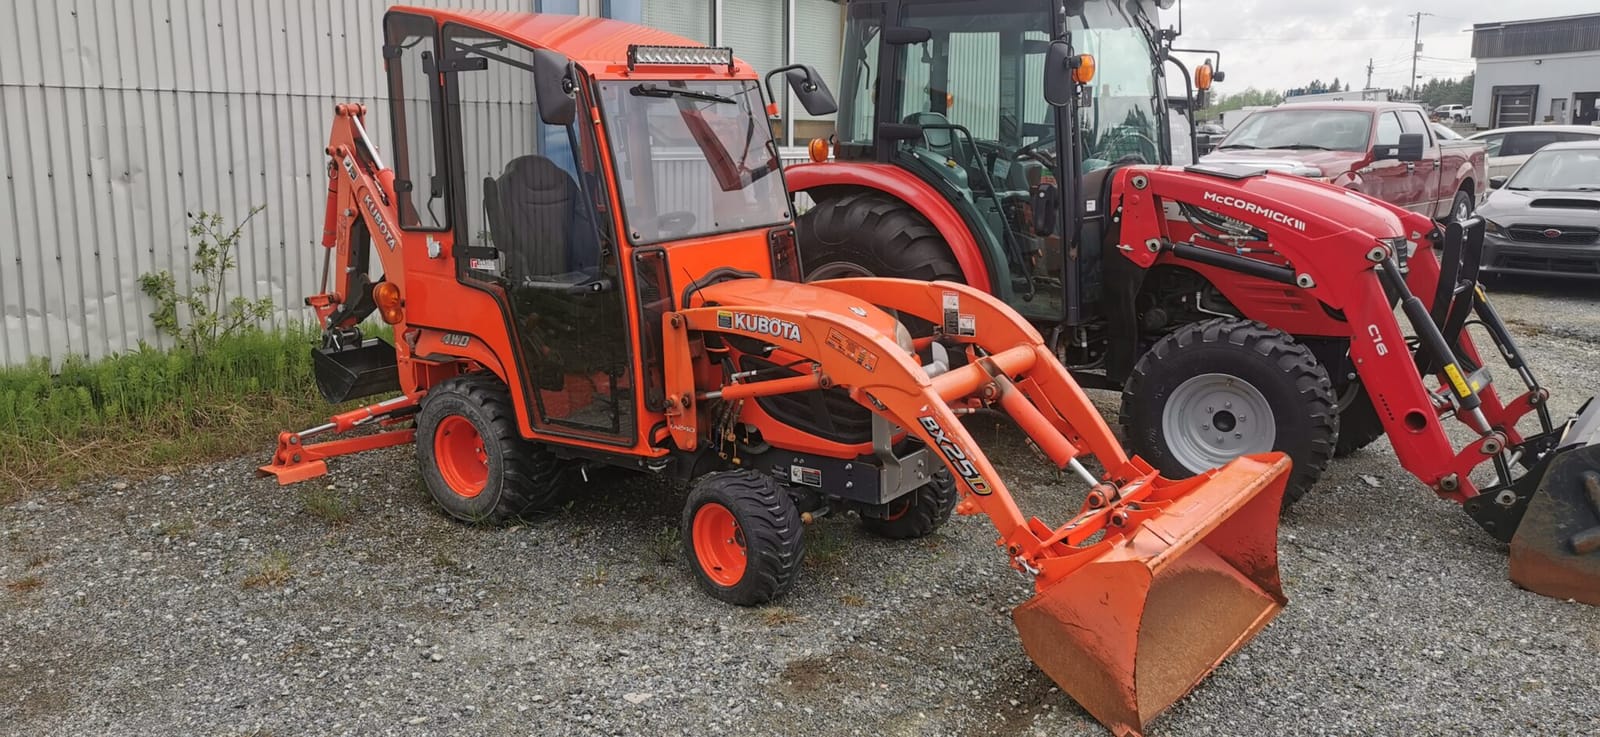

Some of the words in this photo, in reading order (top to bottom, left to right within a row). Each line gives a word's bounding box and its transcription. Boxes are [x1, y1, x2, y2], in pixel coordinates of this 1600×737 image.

[364, 194, 396, 251] KUBOTA
[442, 333, 470, 347] 4WD
[734, 312, 802, 342] KUBOTA
[1368, 324, 1388, 356] C16
[917, 416, 992, 495] BX25D
